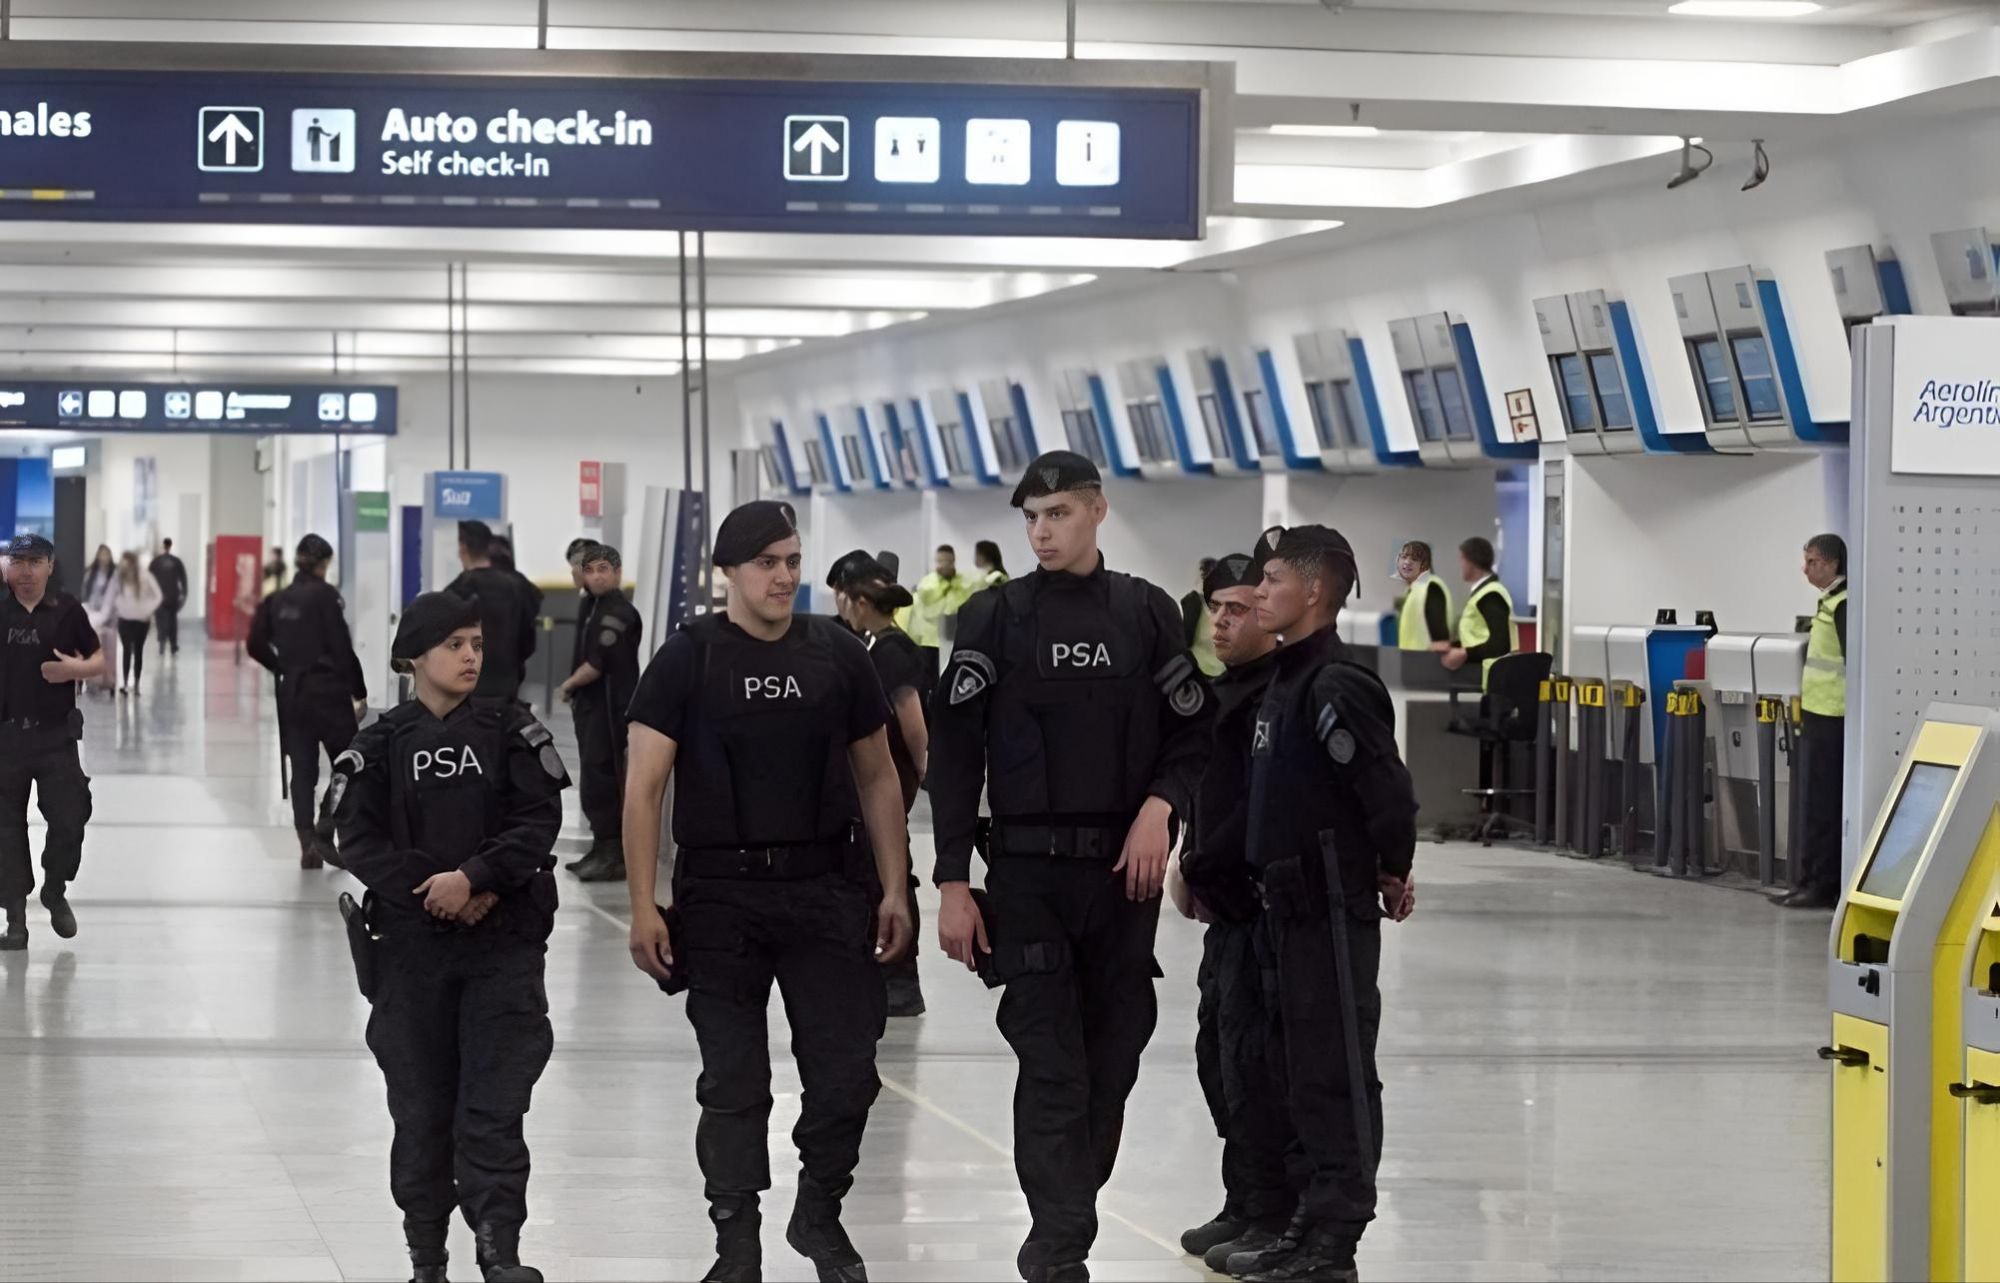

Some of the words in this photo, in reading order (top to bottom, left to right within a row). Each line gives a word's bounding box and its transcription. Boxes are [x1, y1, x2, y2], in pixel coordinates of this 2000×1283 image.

[381, 108, 478, 143] Auto
[486, 108, 652, 145] check-in
[381, 150, 433, 175] Self
[437, 150, 550, 177] check-in
[1052, 642, 1111, 667] PSA
[744, 675, 802, 699] PSA
[413, 744, 483, 781] PSA
